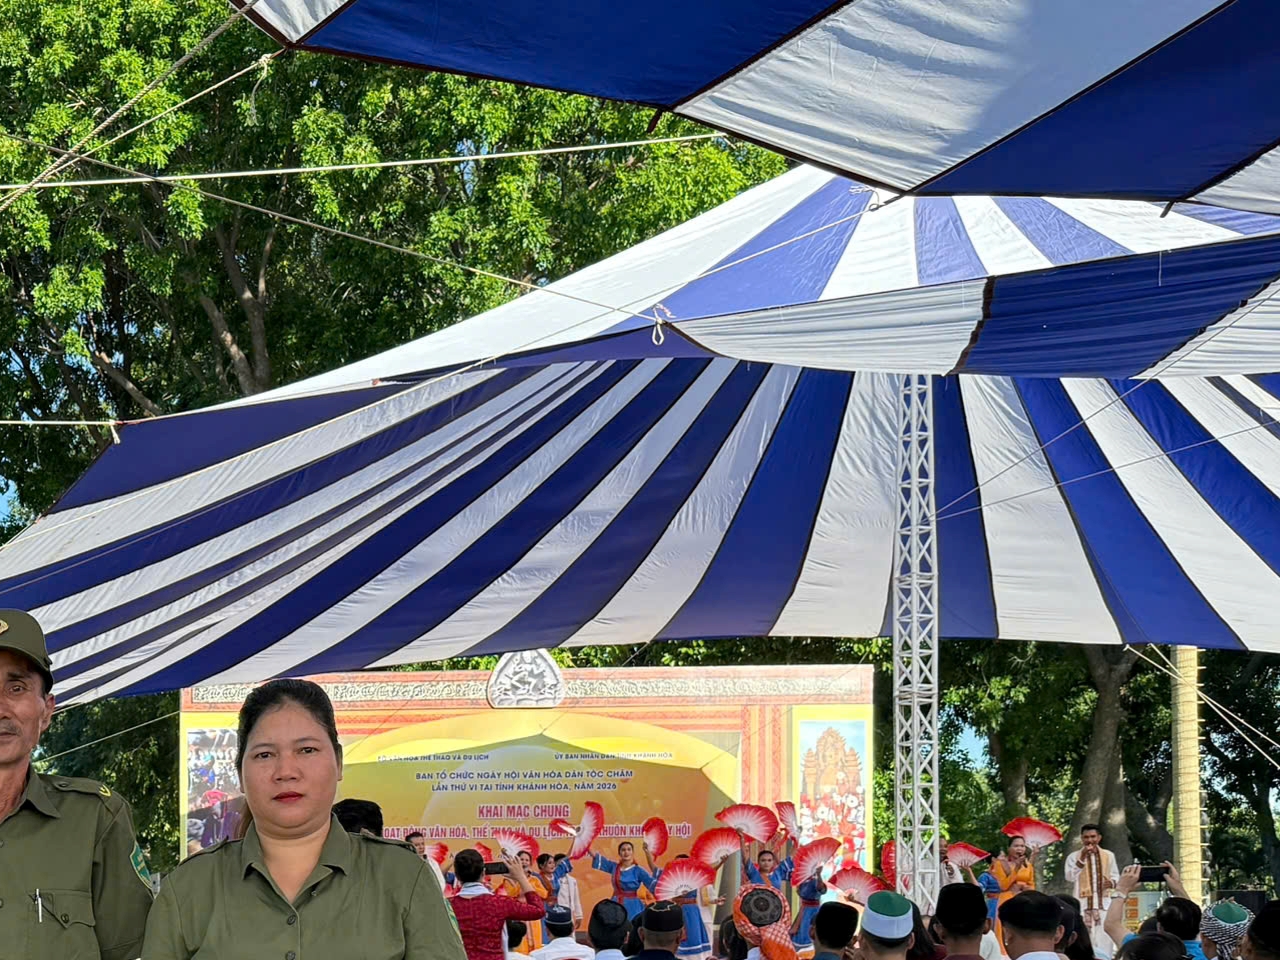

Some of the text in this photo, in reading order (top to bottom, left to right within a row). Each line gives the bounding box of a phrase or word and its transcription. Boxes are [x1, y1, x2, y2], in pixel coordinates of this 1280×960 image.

[580, 752, 599, 760] NHÂN
[416, 772, 433, 780] BAN
[449, 769, 474, 780] CHỨC
[477, 770, 501, 779] NGÀY
[504, 769, 520, 780] HỘI
[523, 769, 540, 779] VĂN
[543, 769, 562, 779] HÓA
[565, 769, 584, 778] DÂN
[586, 769, 604, 779] TỘC
[607, 768, 633, 778] CHĂM
[469, 783, 477, 791] VI
[480, 783, 492, 792] TẠI
[517, 781, 547, 791] KHÁNH
[574, 781, 594, 790] NĂM
[597, 782, 617, 790] 2026
[478, 804, 569, 821] KHAI MẠC CHUNG
[384, 827, 400, 839] OẠT
[429, 824, 448, 838] VĂN
[675, 822, 691, 838] HỘI
